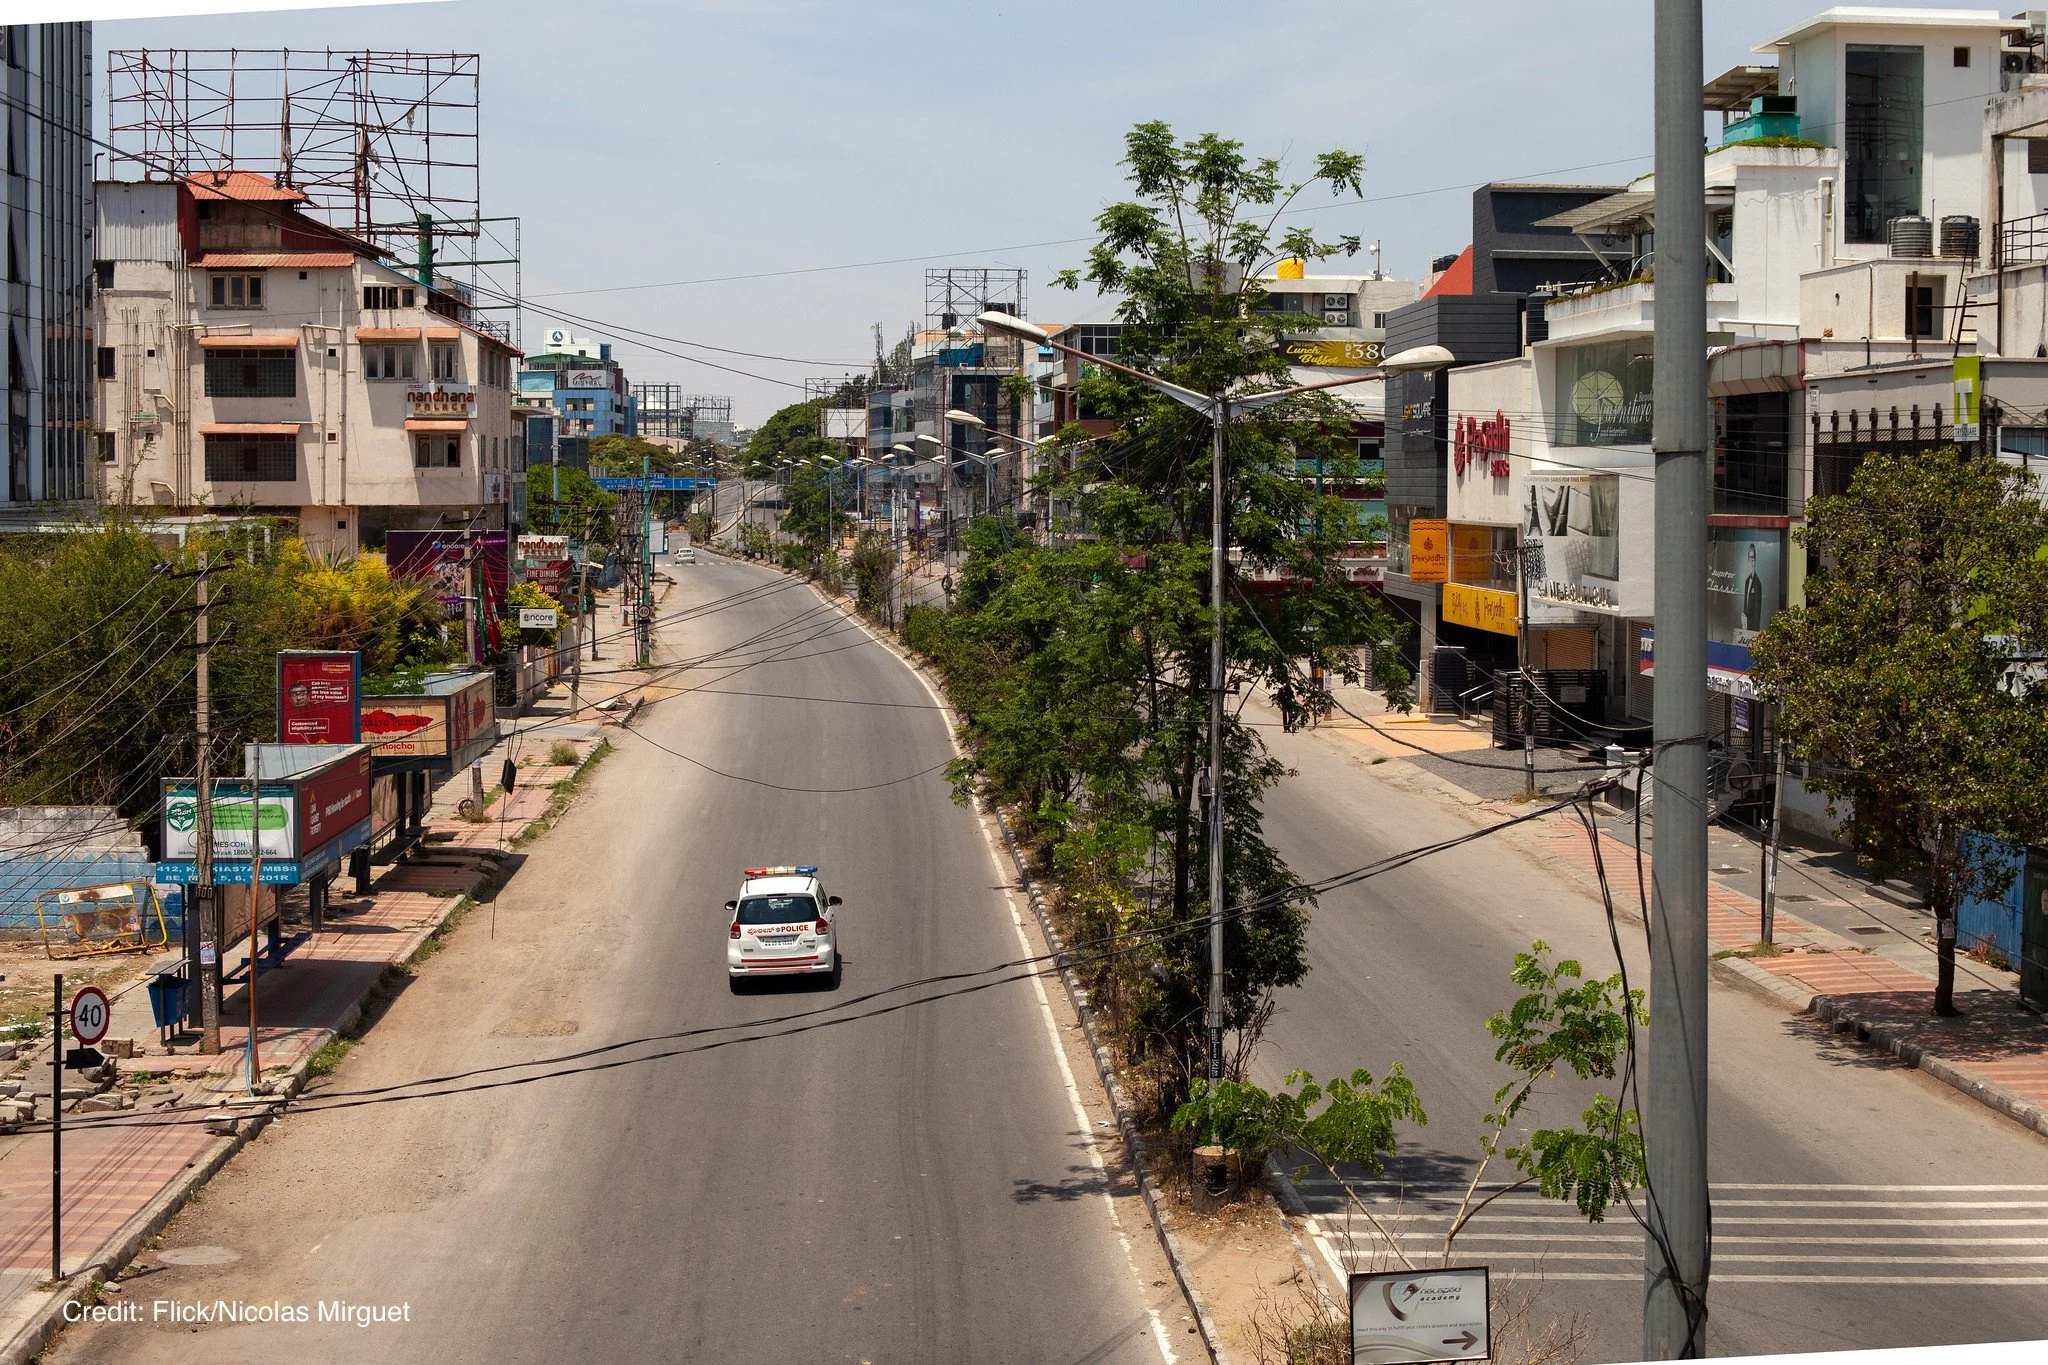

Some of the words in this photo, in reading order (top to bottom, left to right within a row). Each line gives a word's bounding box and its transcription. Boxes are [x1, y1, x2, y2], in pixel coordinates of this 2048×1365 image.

[1286, 345, 1320, 354] Lunch
[1299, 354, 1339, 365] Buffet
[407, 386, 475, 402] nandhana
[1412, 553, 1445, 564] Prasiddhi
[526, 570, 539, 578] FINE
[540, 570, 559, 578] DINING
[781, 924, 810, 933] POLICE
[79, 1004, 102, 1027] 40
[1420, 1294, 1461, 1302] academy
